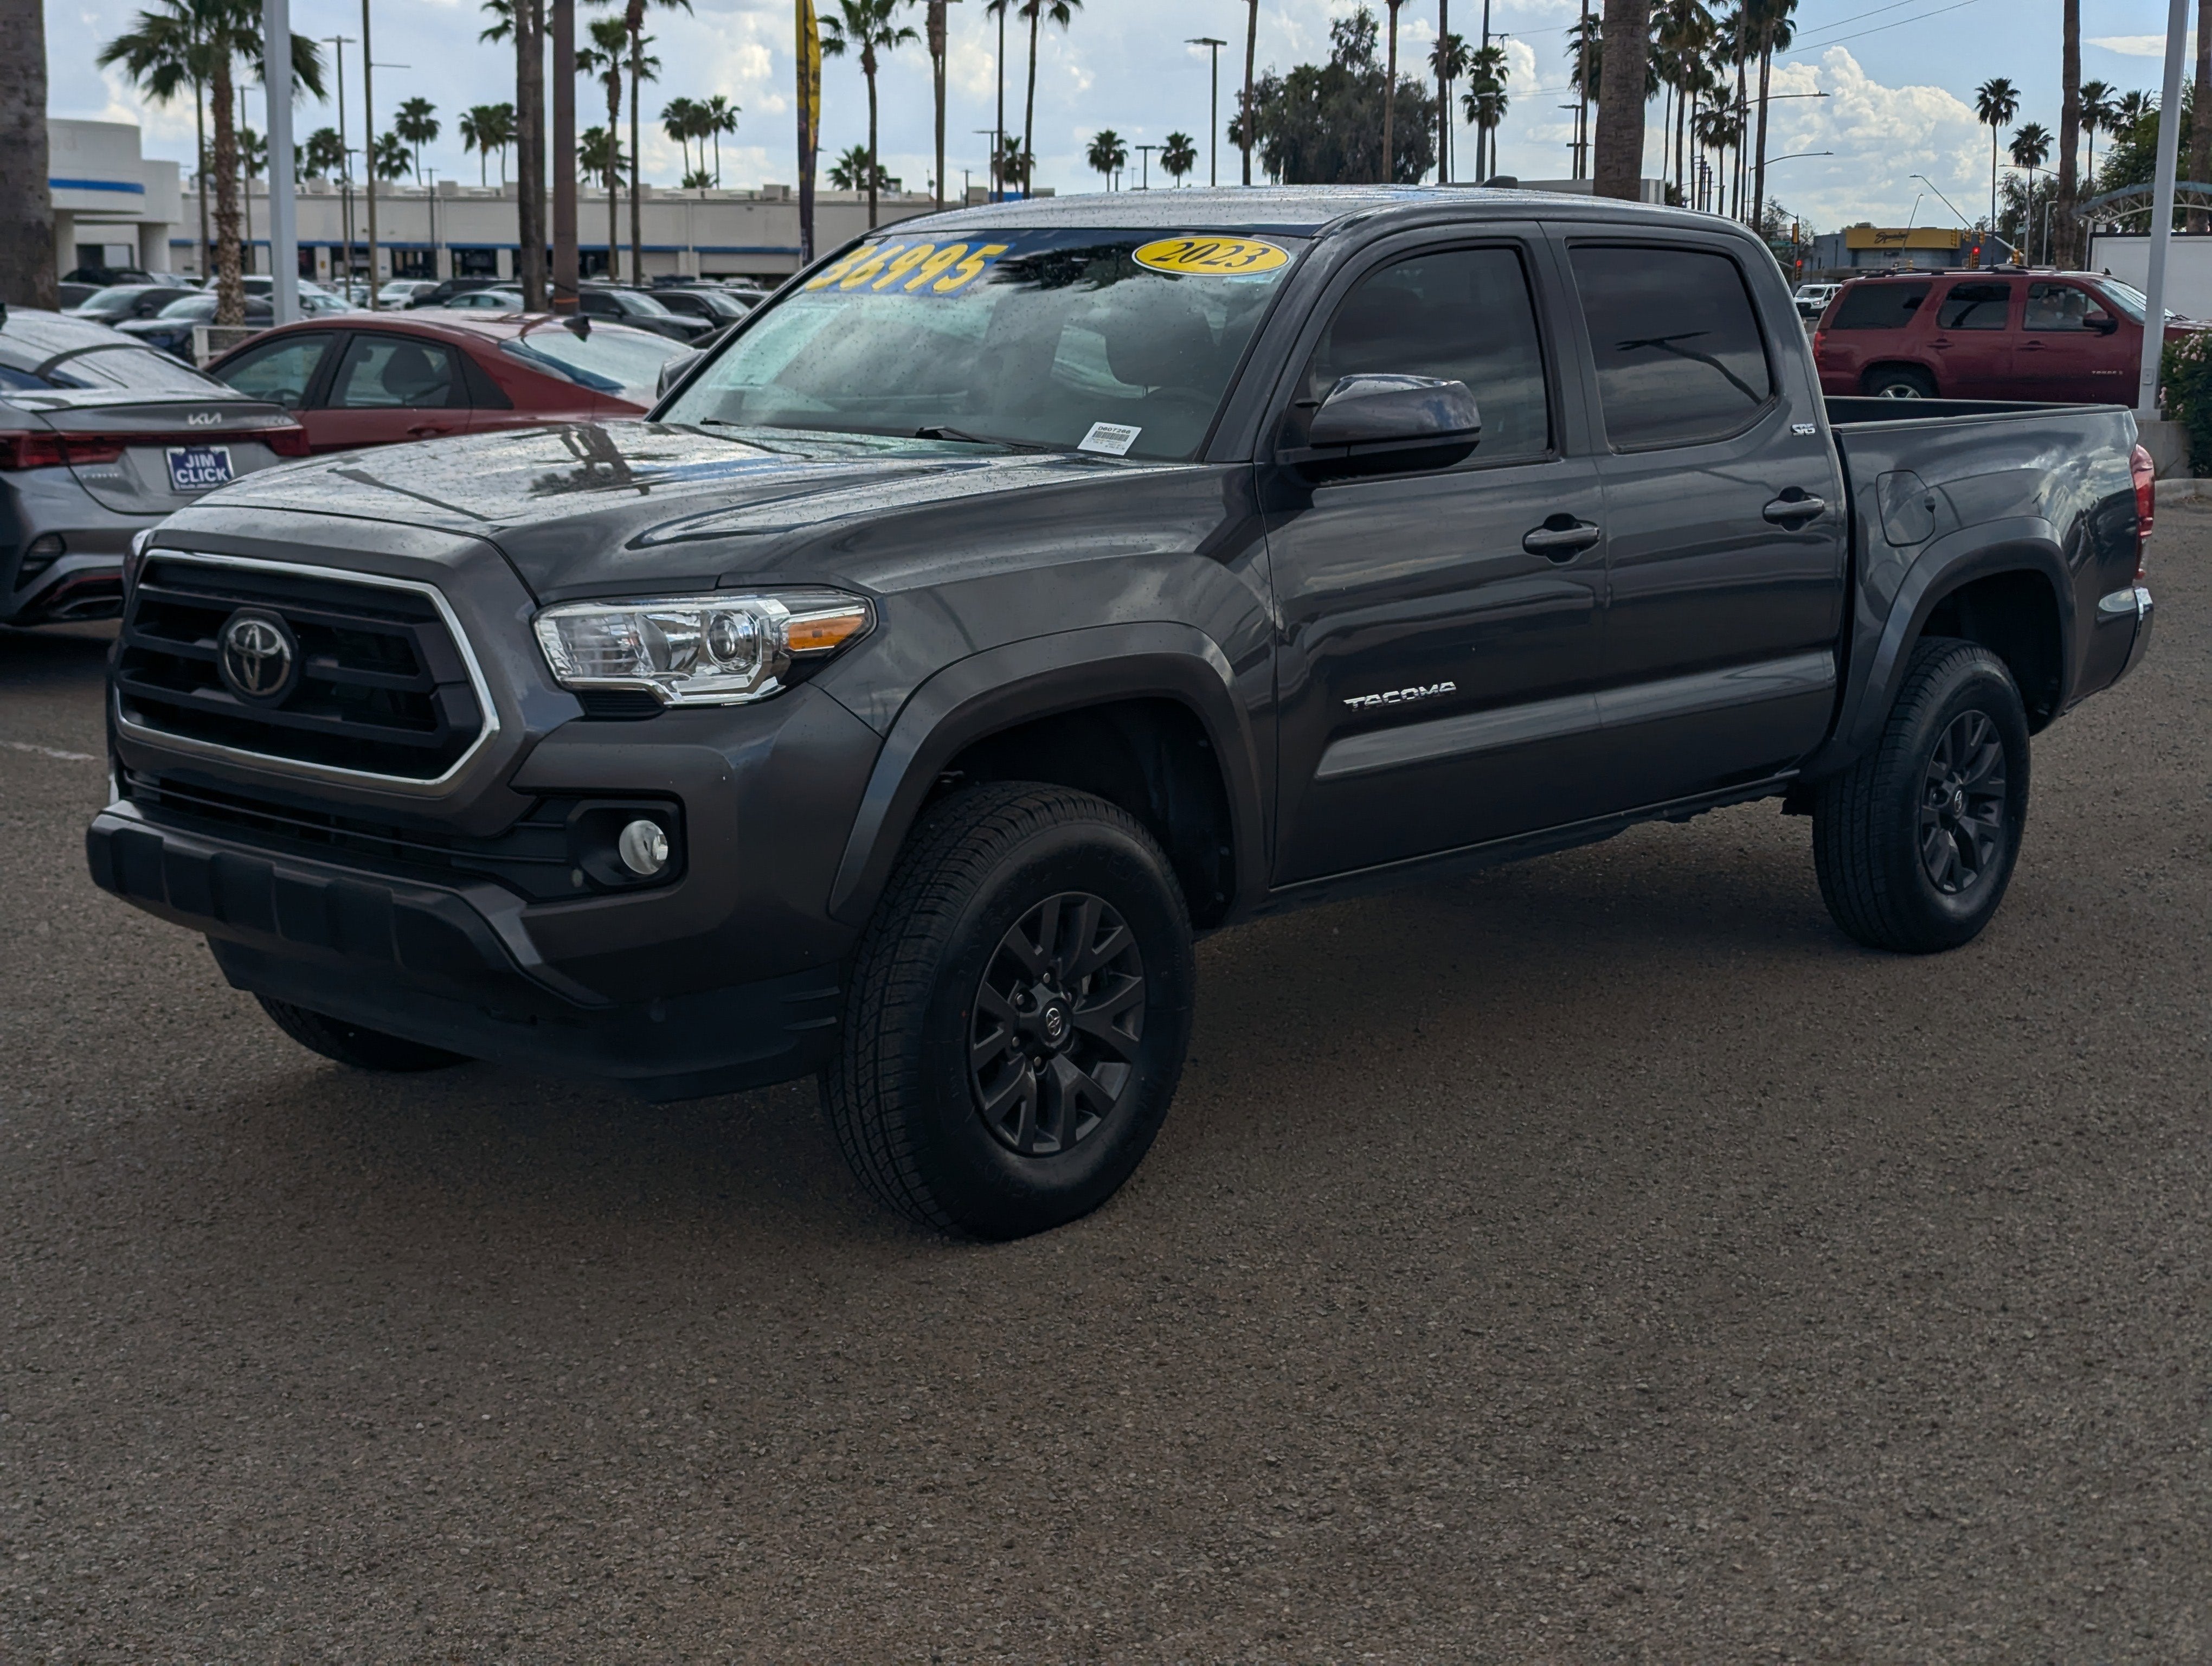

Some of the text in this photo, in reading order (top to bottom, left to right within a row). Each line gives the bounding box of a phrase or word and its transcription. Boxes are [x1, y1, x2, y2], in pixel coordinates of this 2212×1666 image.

[1149, 242, 1271, 268] 2023
[805, 244, 1009, 293] 36995
[188, 412, 222, 425] KIA
[185, 453, 216, 468] JIM
[176, 467, 229, 483] CLICK
[1343, 681, 1457, 709] TACOMA
